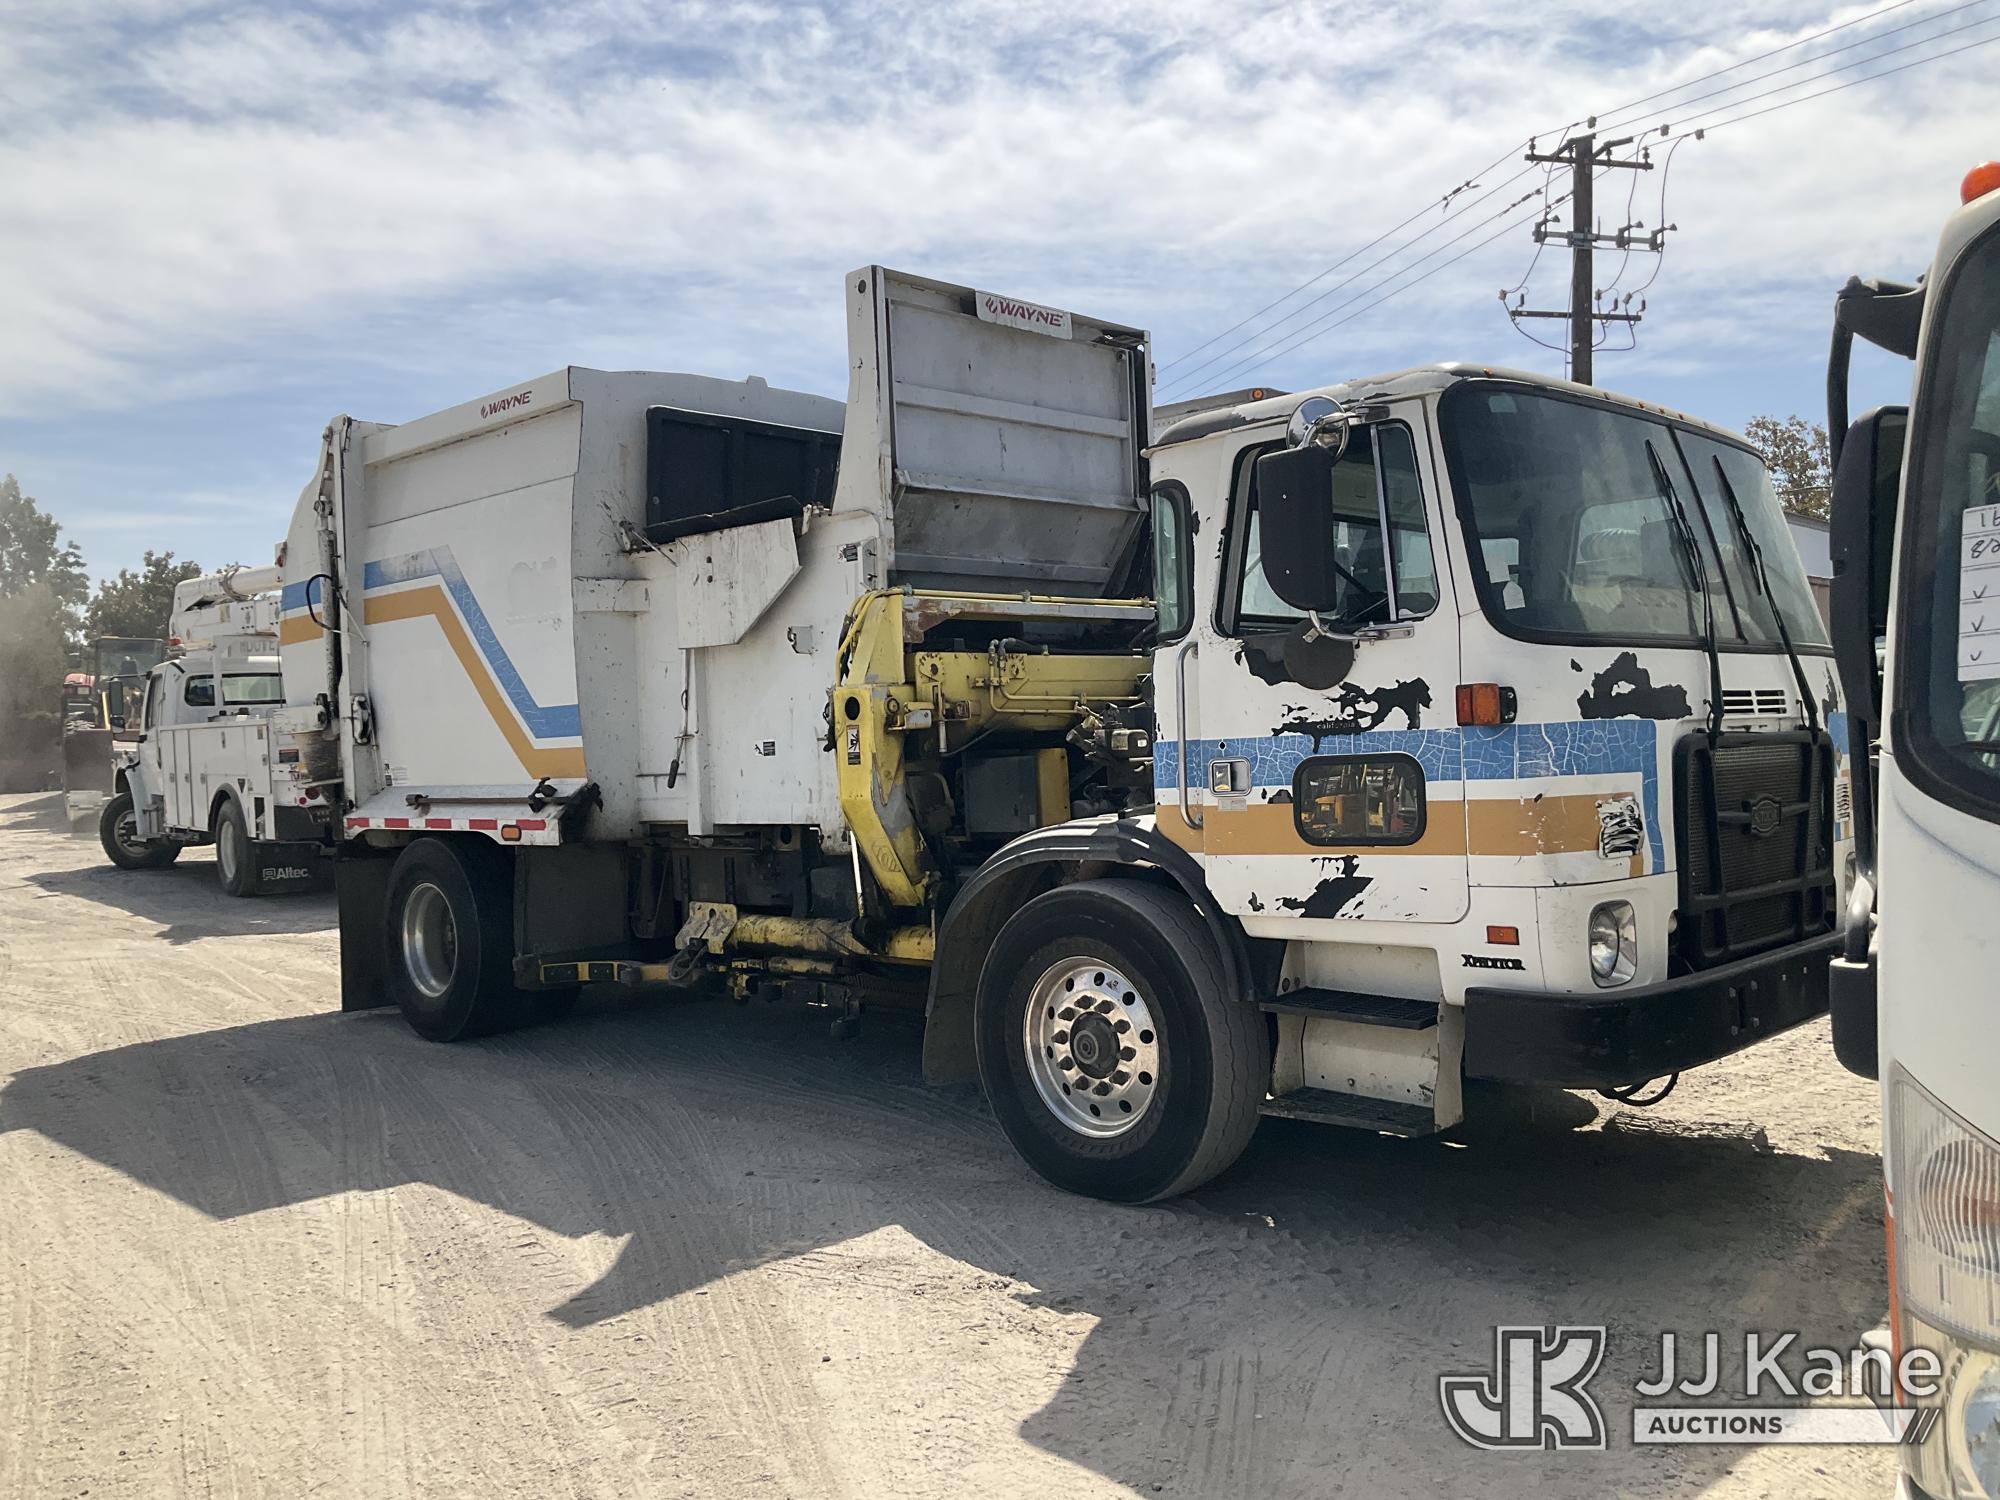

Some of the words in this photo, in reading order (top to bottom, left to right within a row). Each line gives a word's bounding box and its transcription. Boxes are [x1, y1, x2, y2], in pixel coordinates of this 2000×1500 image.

[999, 299, 1063, 327] WAYNE
[489, 390, 532, 415] WAYNE
[277, 867, 309, 879] Altec
